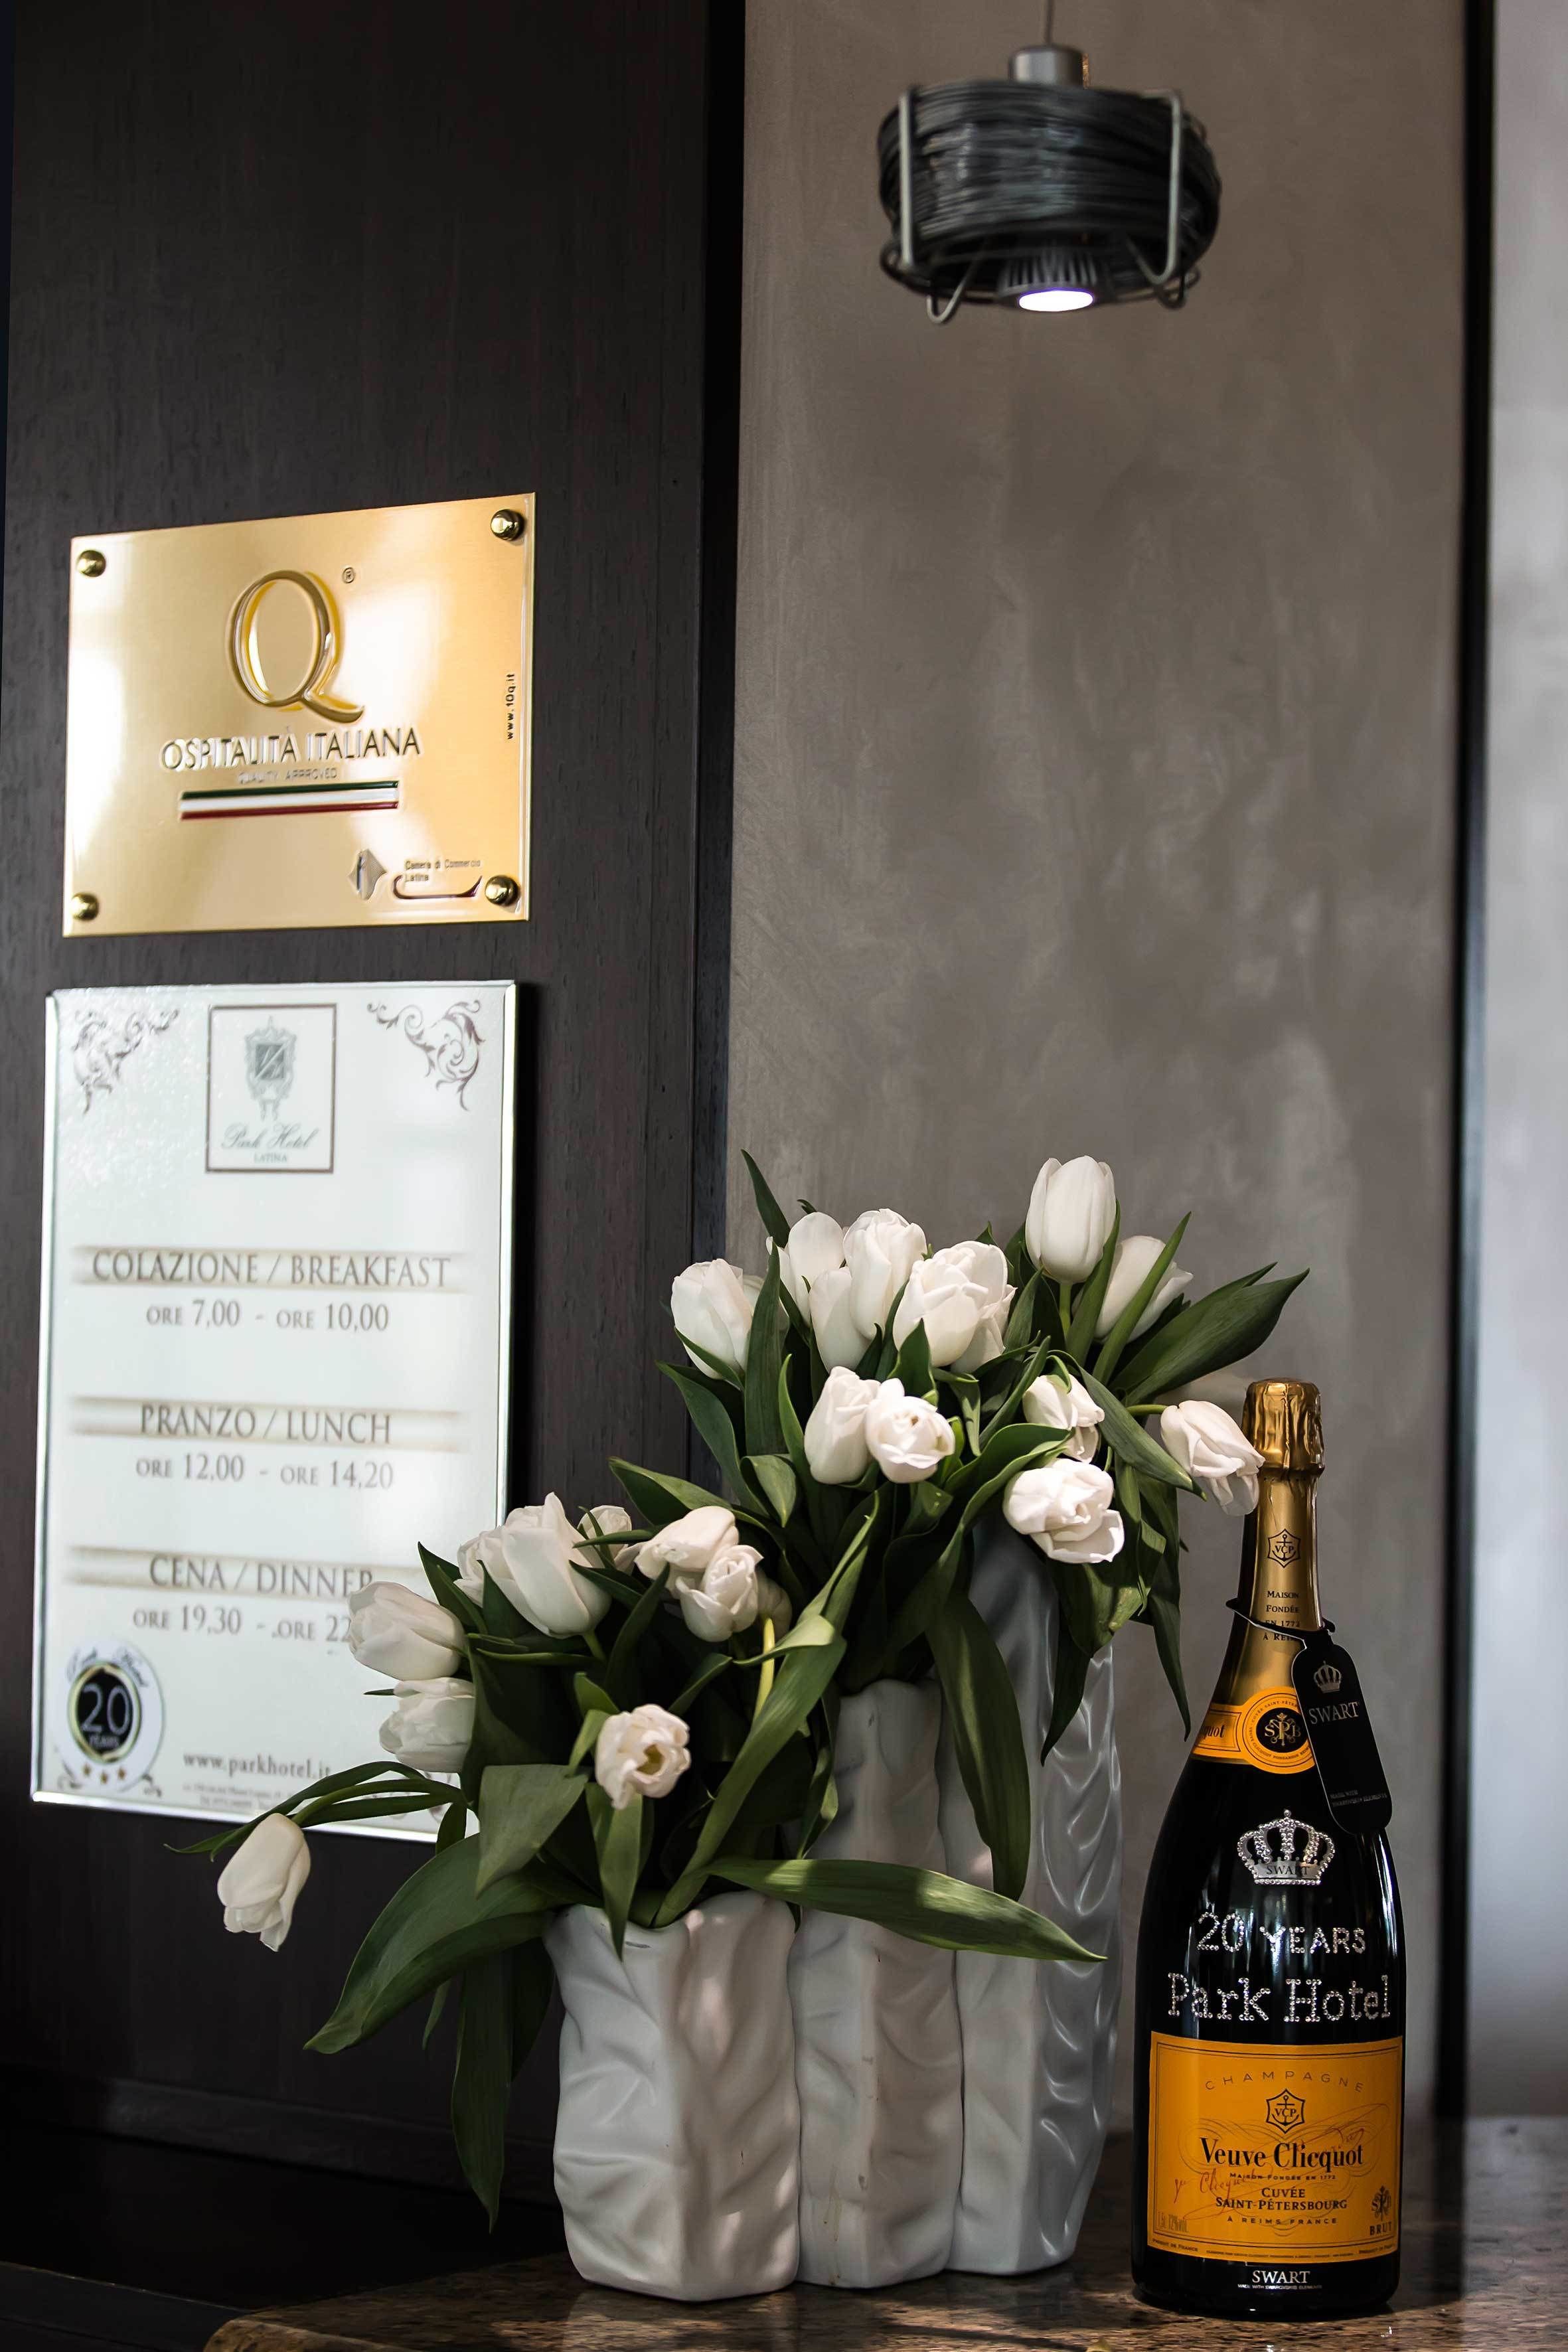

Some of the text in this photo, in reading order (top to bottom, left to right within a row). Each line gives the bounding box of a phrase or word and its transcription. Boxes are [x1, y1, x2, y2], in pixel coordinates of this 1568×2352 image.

[229, 570, 364, 724] Q
[505, 673, 516, 740] www.10q.it
[161, 727, 421, 770] OSPITALITÀ ITALIANA
[285, 767, 338, 781] APPROVED
[267, 1123, 320, 1149] Hotel
[254, 1152, 287, 1163] LATINA
[92, 1250, 259, 1284] COLAZIONE
[290, 1254, 451, 1288] BREAKFAST
[146, 1306, 183, 1326] ORE
[275, 1309, 315, 1329] ORE
[140, 1403, 256, 1439] PRANZO
[286, 1409, 392, 1445] LUNCH
[135, 1458, 173, 1478] ORE
[280, 1466, 319, 1486] ORE
[1275, 1545, 1294, 1554] VCP
[149, 1554, 227, 1591] CENA
[133, 1609, 170, 1630] ORE
[1266, 1605, 1300, 1613] FONDÉE
[82, 1682, 132, 1736] 20
[1308, 1701, 1360, 1725] SWART
[1196, 1912, 1366, 1954] 20 YEARS
[1168, 1972, 1391, 2022] Park Hotel
[1205, 2071, 1364, 2092] CHAMPAGNE
[1275, 2107, 1296, 2118] VCP
[1200, 2137, 1267, 2167] Veuve
[1274, 2142, 1364, 2173] Clicquot
[1215, 2197, 1348, 2211] SAINT-PÉTERSBOURG
[1261, 2187, 1306, 2198] CUVÉE
[1370, 2221, 1392, 2236] BRUT
[1252, 2270, 1310, 2284] SWART
